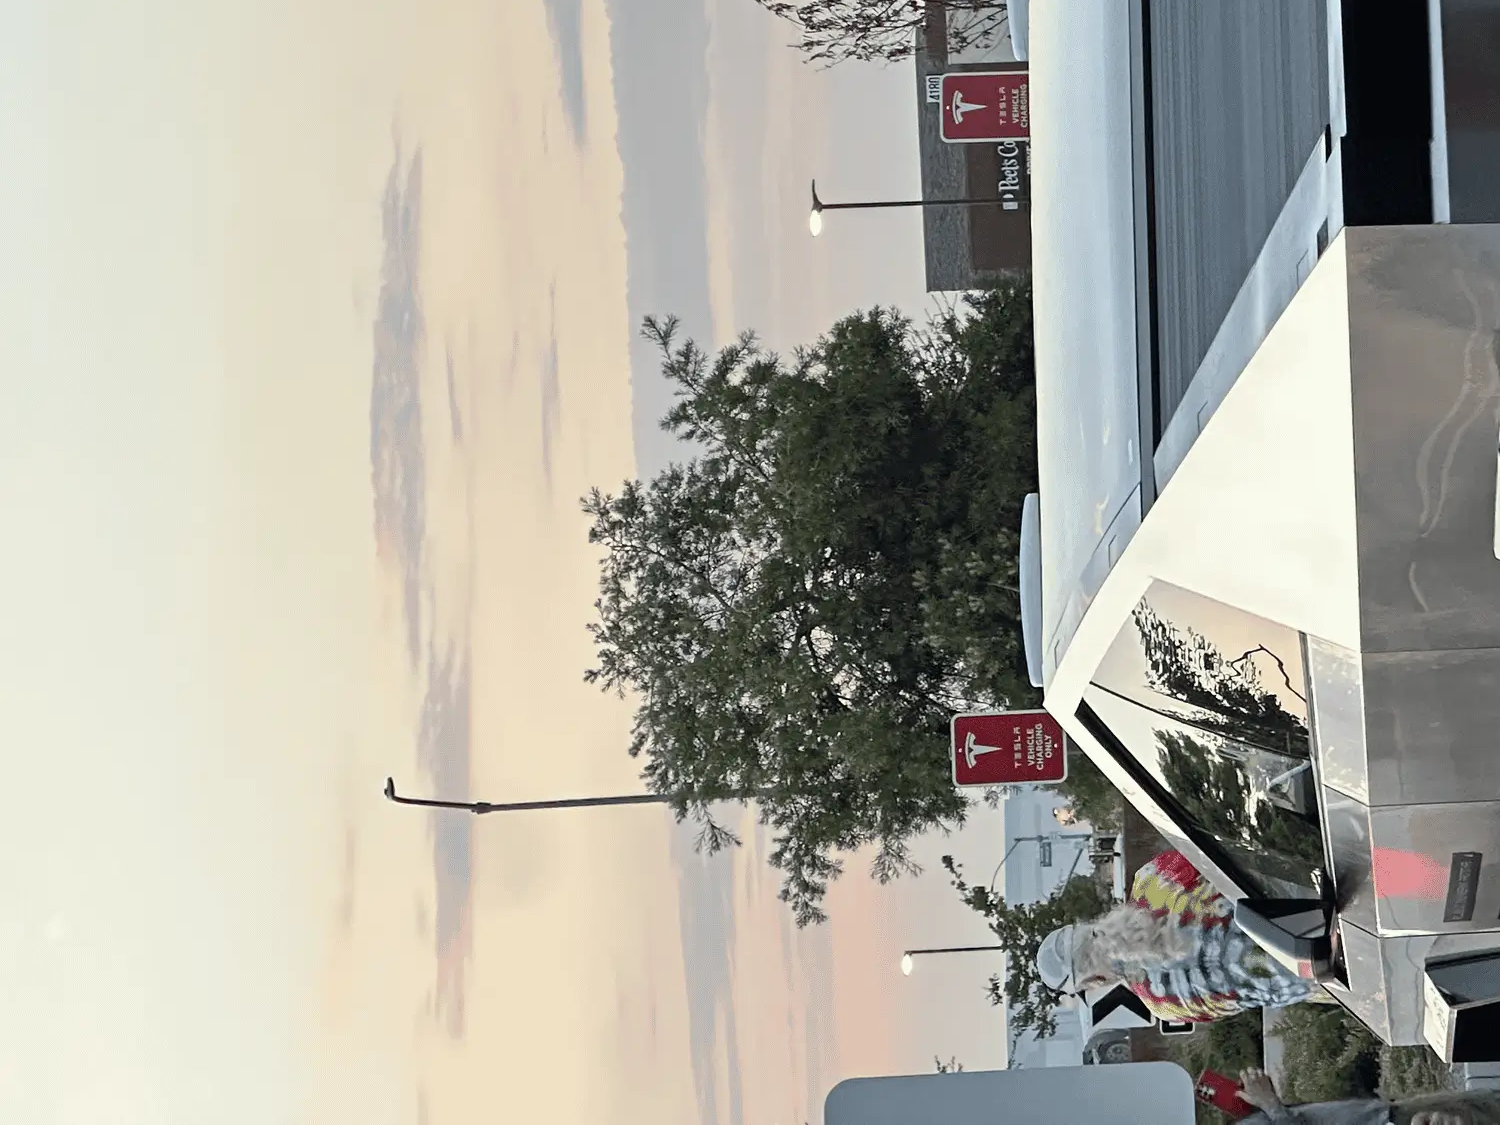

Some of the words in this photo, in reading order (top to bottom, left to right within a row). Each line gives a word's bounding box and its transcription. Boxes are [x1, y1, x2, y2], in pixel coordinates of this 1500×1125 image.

[999, 86, 1007, 125] TESLA
[1011, 88, 1019, 123] VEHICLE
[1020, 83, 1028, 128] CHARGING
[998, 159, 1019, 192] Peet's
[1013, 726, 1022, 768] TESLA
[1026, 728, 1035, 766] VEHICLE
[1035, 723, 1044, 770] CHARGING
[1044, 734, 1052, 758] ONLY
